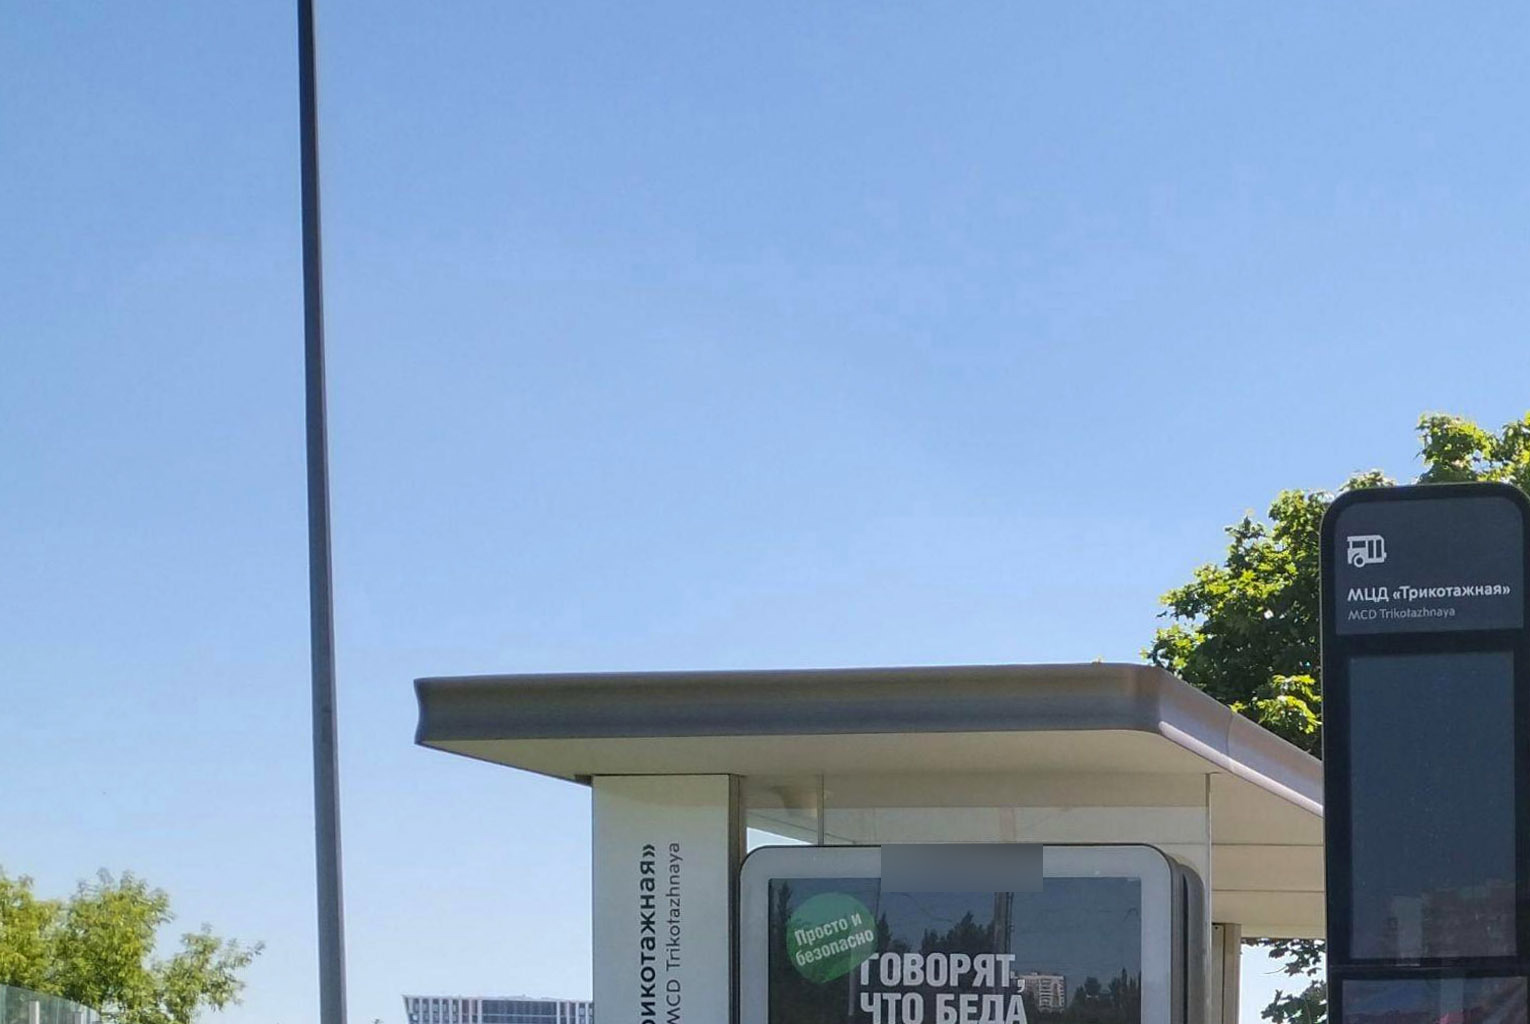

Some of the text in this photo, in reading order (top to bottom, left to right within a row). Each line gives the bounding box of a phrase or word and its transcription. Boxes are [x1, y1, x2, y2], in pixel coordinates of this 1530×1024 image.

[1347, 584, 1511, 603] МЦД «Трикотажная»
[1347, 607, 1456, 620] MCD Trikotazhnaya
[666, 842, 684, 972] Trikotazhnaya
[794, 912, 862, 946] Просто и
[795, 929, 875, 967] безопасно
[860, 952, 1026, 993] ГОВОРЯТ,
